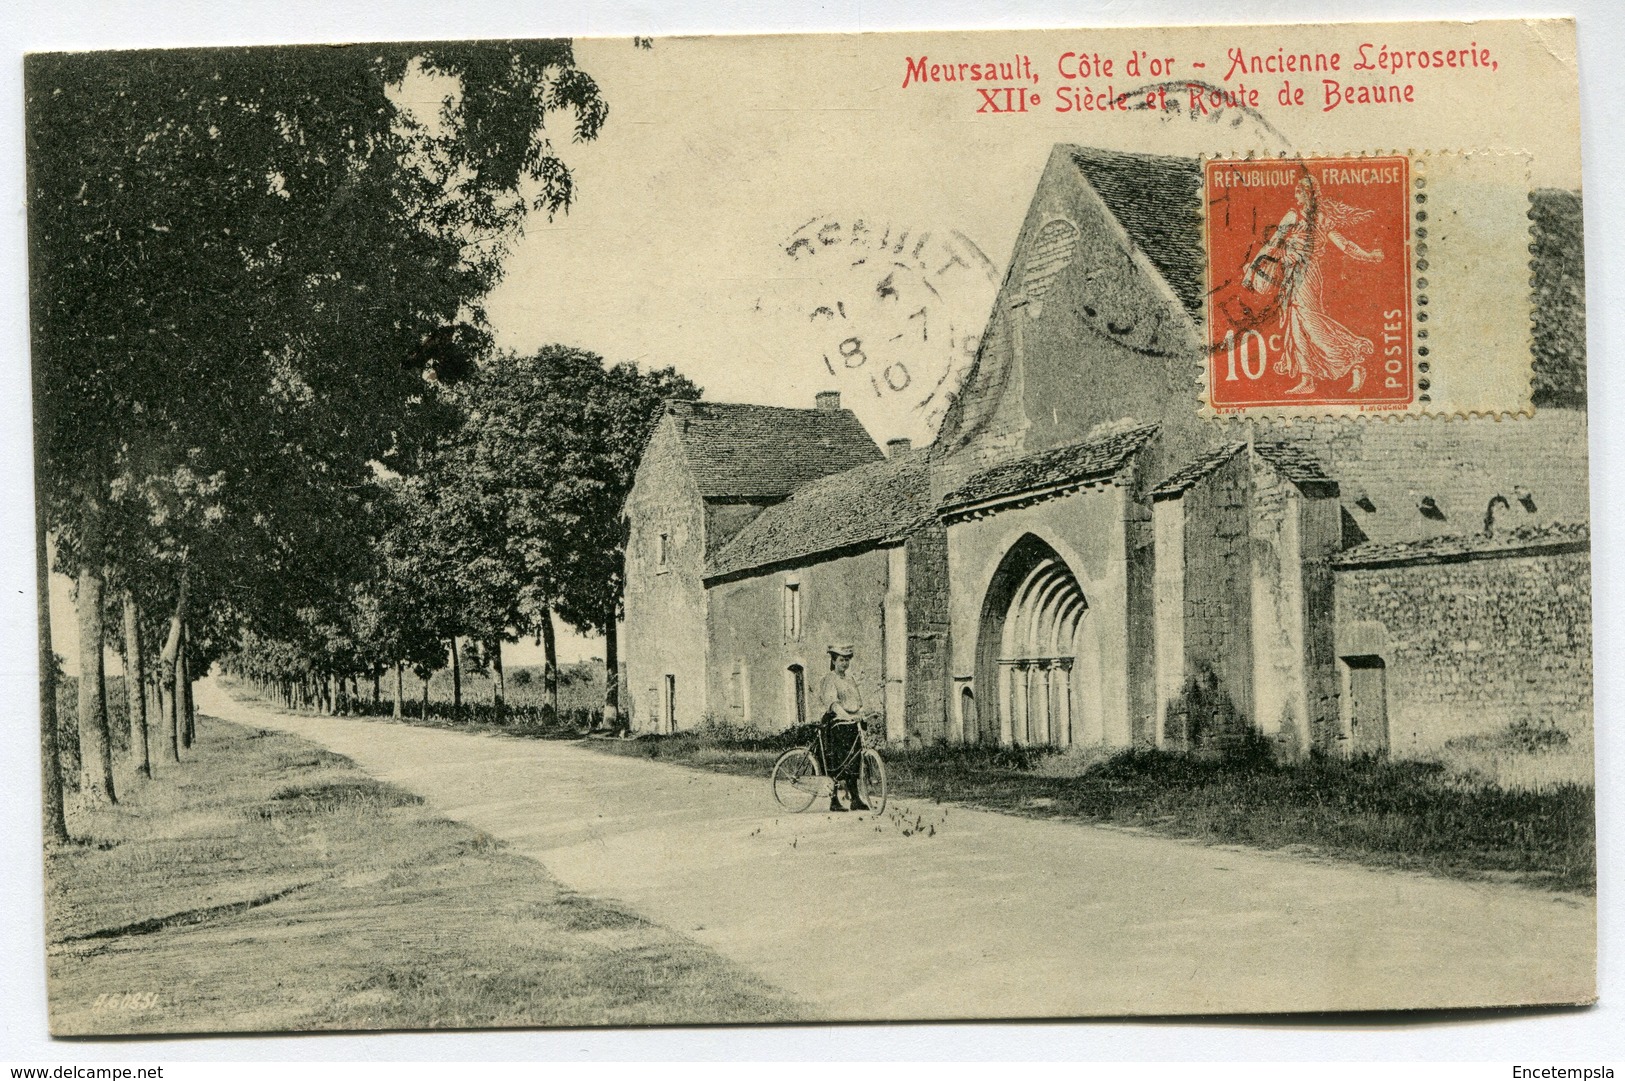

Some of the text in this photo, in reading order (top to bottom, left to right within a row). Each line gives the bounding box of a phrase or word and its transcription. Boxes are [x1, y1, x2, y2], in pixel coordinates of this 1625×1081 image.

[902, 54, 1040, 89] Meursault,
[1057, 51, 1113, 80] Côte
[1125, 50, 1175, 77] d'or
[1223, 47, 1341, 82] Ancienne
[1353, 42, 1499, 75] Léproserie,
[1055, 86, 1128, 113] Siècle
[1146, 87, 1168, 110] et
[1186, 83, 1259, 117] Route
[1277, 80, 1304, 107] de
[1321, 79, 1414, 113] Beaune
[1322, 167, 1400, 187] FRANÇAISE
[1384, 308, 1402, 390] POSTES
